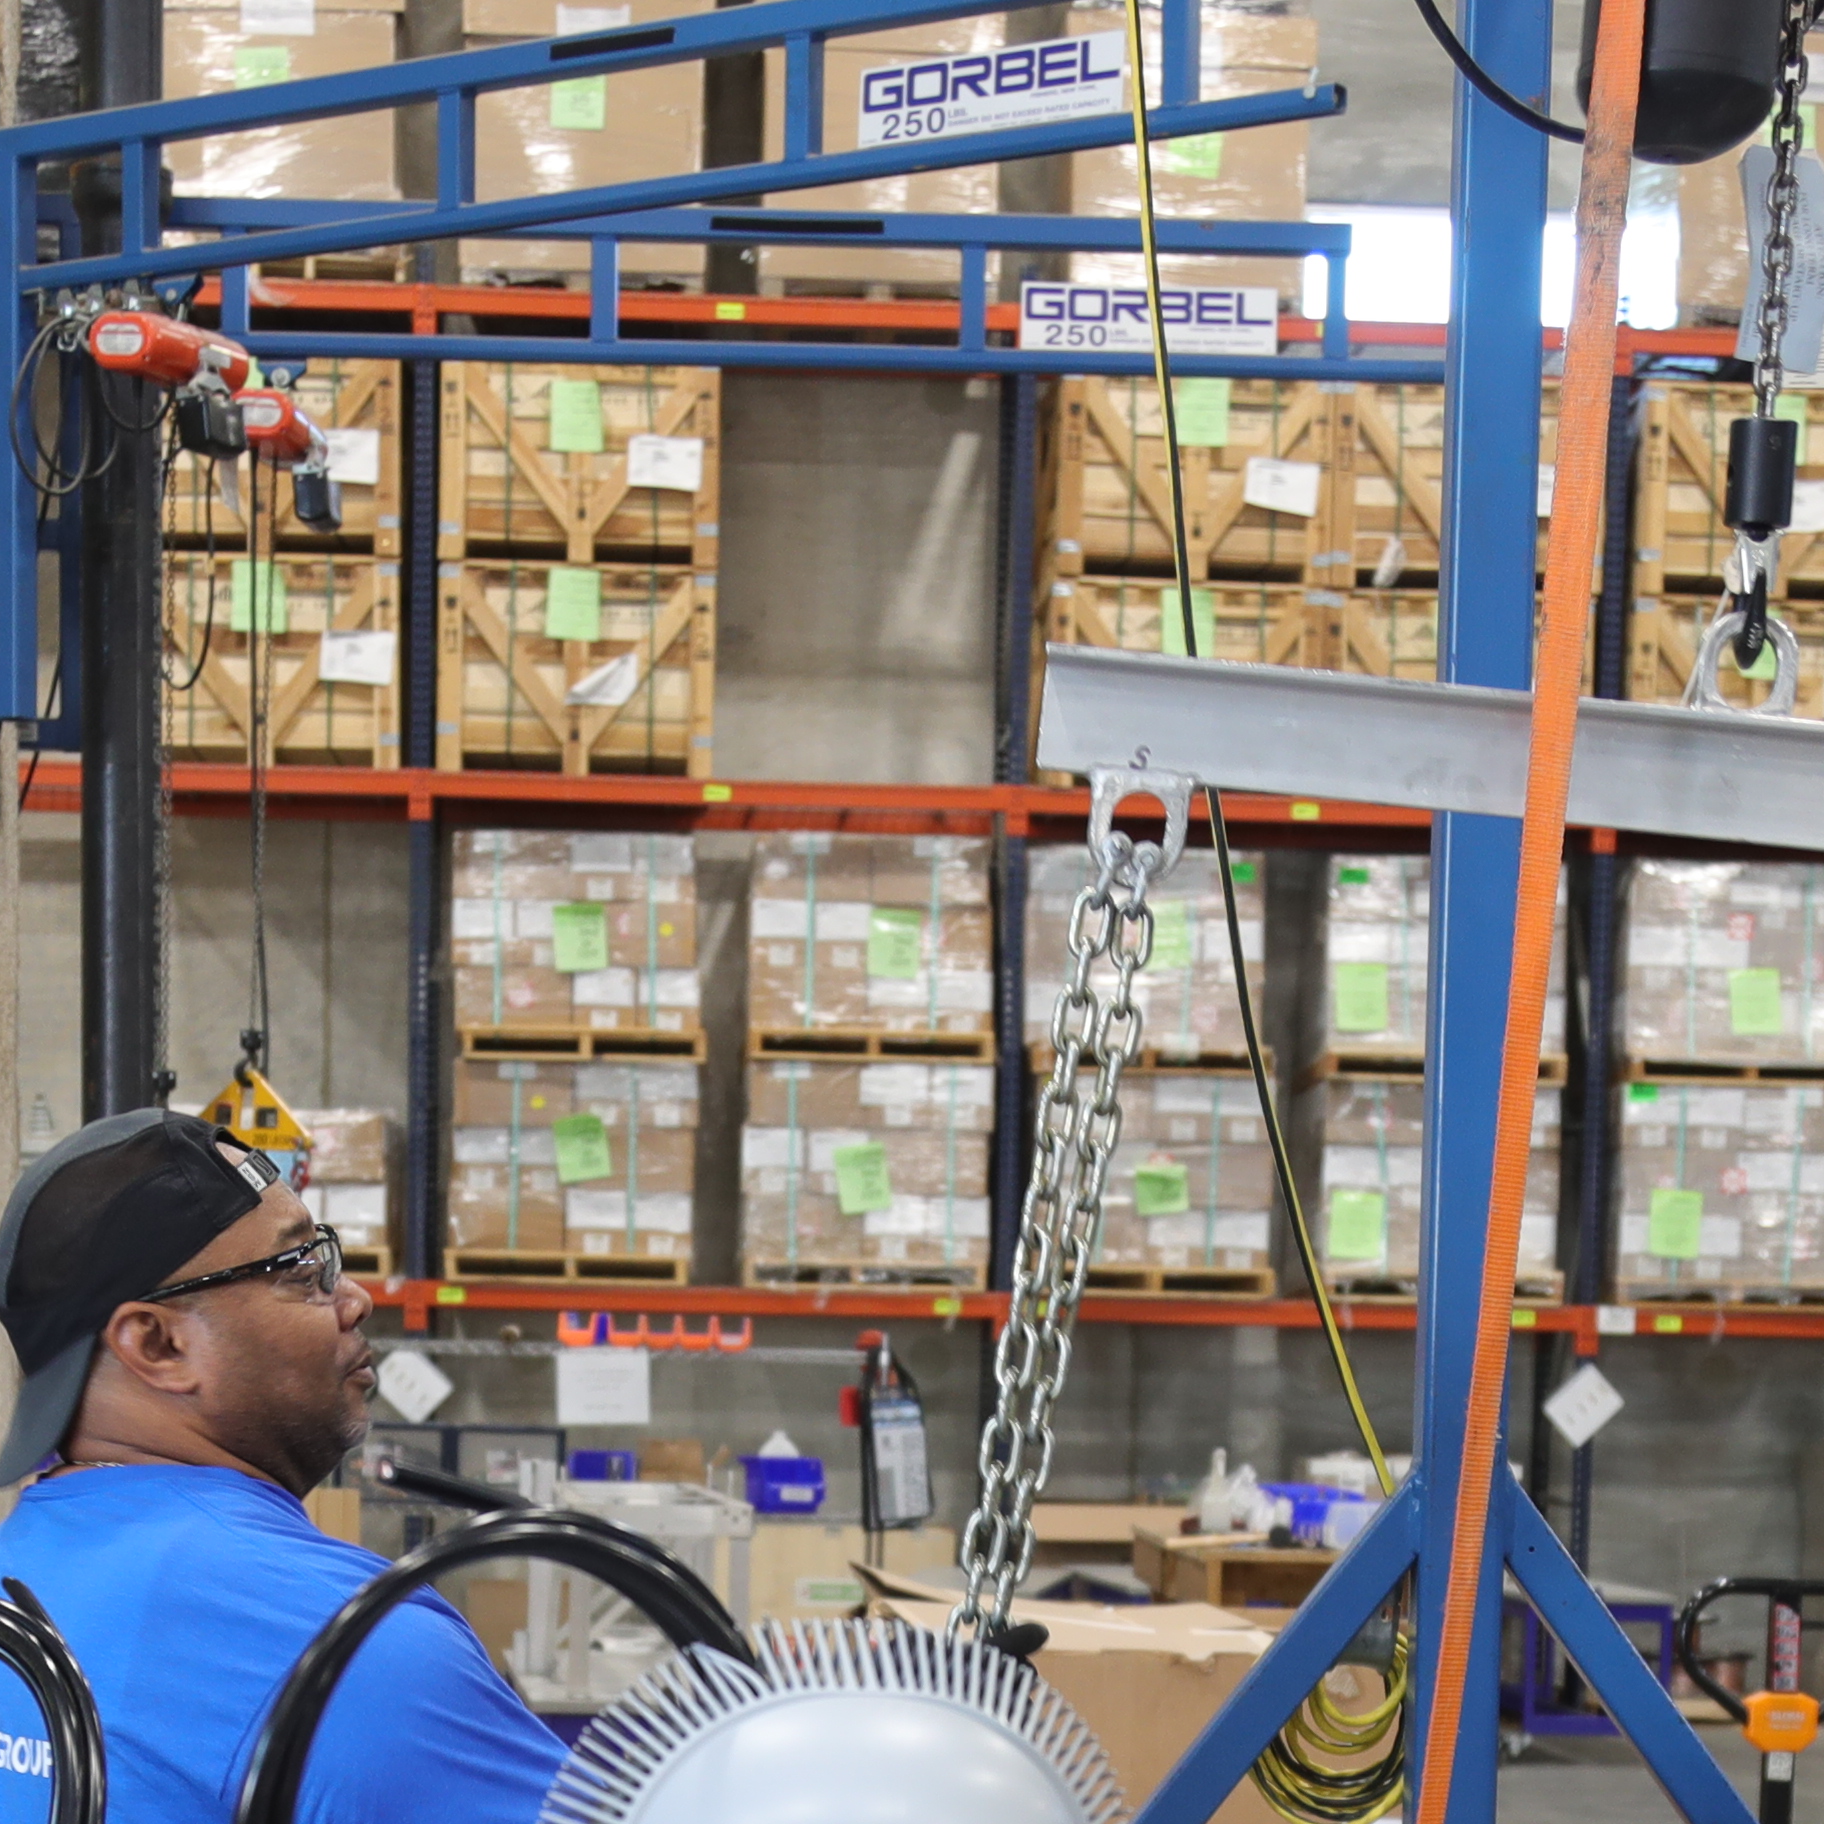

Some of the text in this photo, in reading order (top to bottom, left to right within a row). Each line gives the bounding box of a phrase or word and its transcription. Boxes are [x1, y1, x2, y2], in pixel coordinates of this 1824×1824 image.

[863, 40, 1121, 113] GORBEL
[882, 107, 946, 140] 250
[1026, 287, 1273, 326] GORBEL
[1045, 324, 1107, 347] 250
